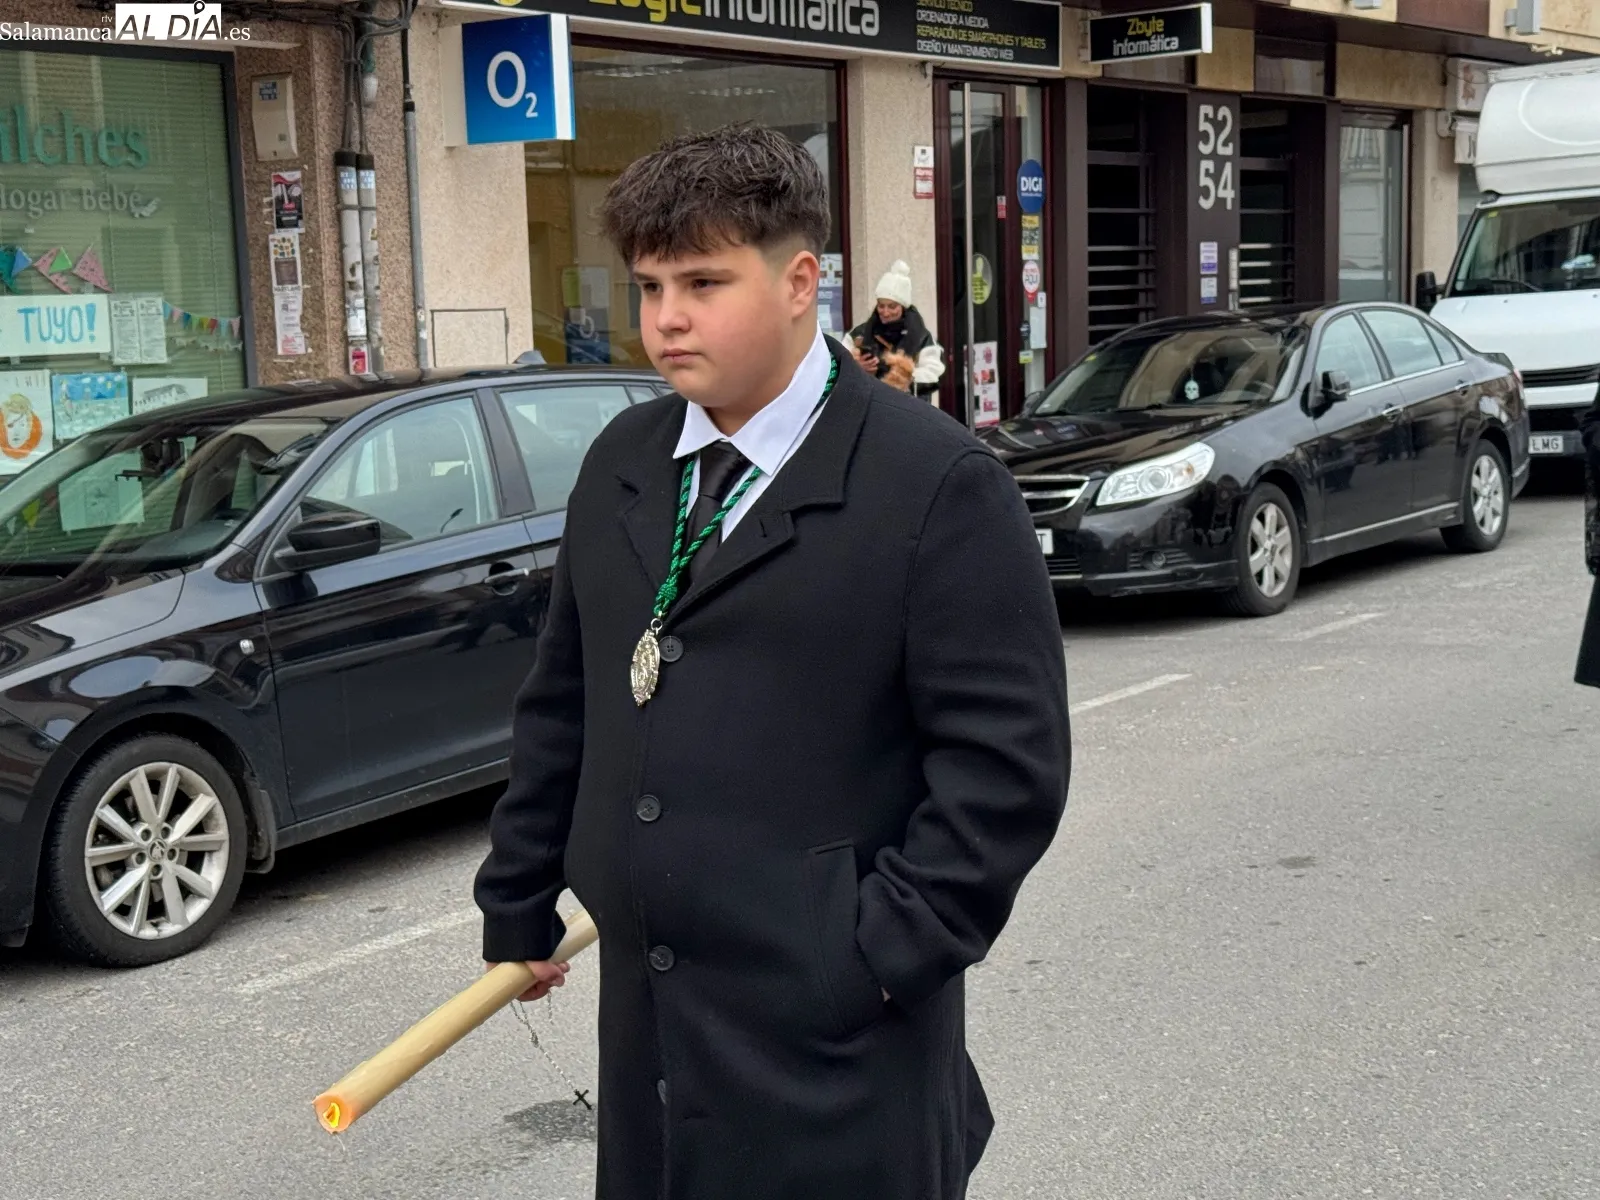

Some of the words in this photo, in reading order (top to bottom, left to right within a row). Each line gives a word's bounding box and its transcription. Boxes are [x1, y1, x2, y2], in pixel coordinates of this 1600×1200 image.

[1127, 16, 1165, 37] Zbyte
[1113, 34, 1179, 56] informática
[1198, 104, 1234, 156] 52
[1021, 176, 1043, 192] DIGI
[1198, 159, 1235, 211] 54
[17, 303, 97, 344] TUYO!
[1532, 438, 1559, 451] LMG
